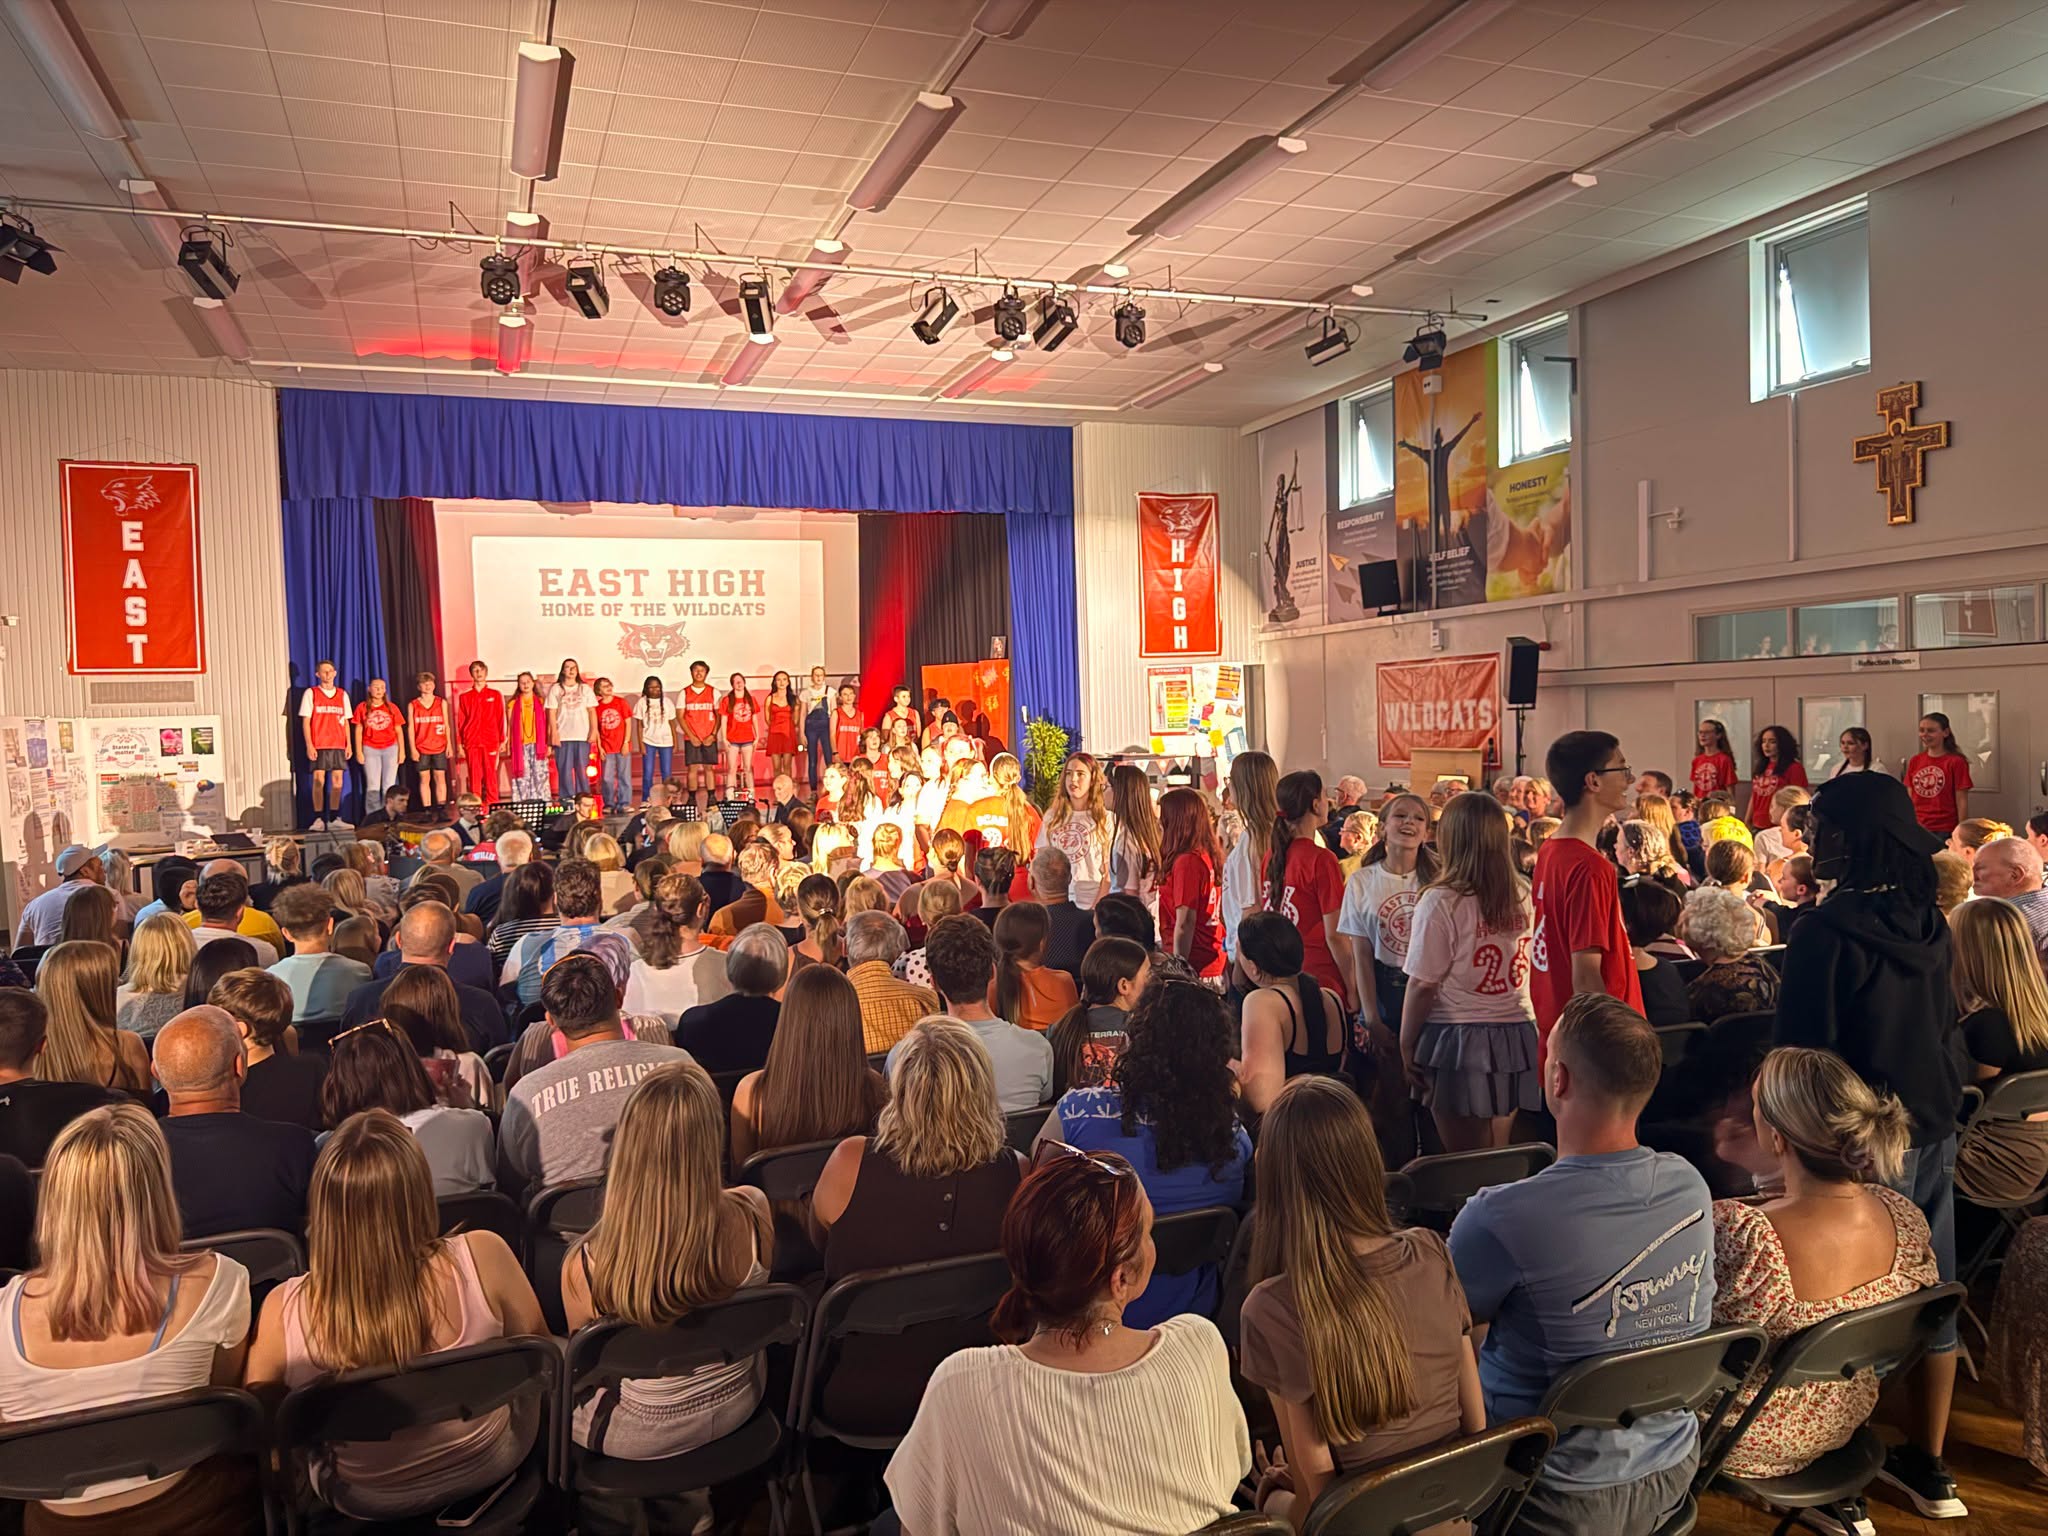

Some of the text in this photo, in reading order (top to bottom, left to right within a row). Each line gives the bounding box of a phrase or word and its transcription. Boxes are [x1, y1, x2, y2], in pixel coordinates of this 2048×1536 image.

[1509, 475, 1548, 493] HONESTY
[1336, 511, 1385, 530] RESPONSIBILITY
[1296, 557, 1317, 569] JUSTICE
[121, 521, 148, 665] EAST
[539, 568, 766, 597] EAST HIGH
[1171, 538, 1188, 650] HIGH
[541, 603, 766, 617] HOME OF THE WILDCATS
[1384, 698, 1494, 732] WILDCATS
[1380, 896, 1402, 919] EAST
[531, 1076, 580, 1119] TRUE
[1635, 1311, 1685, 1329] NEW YORK
